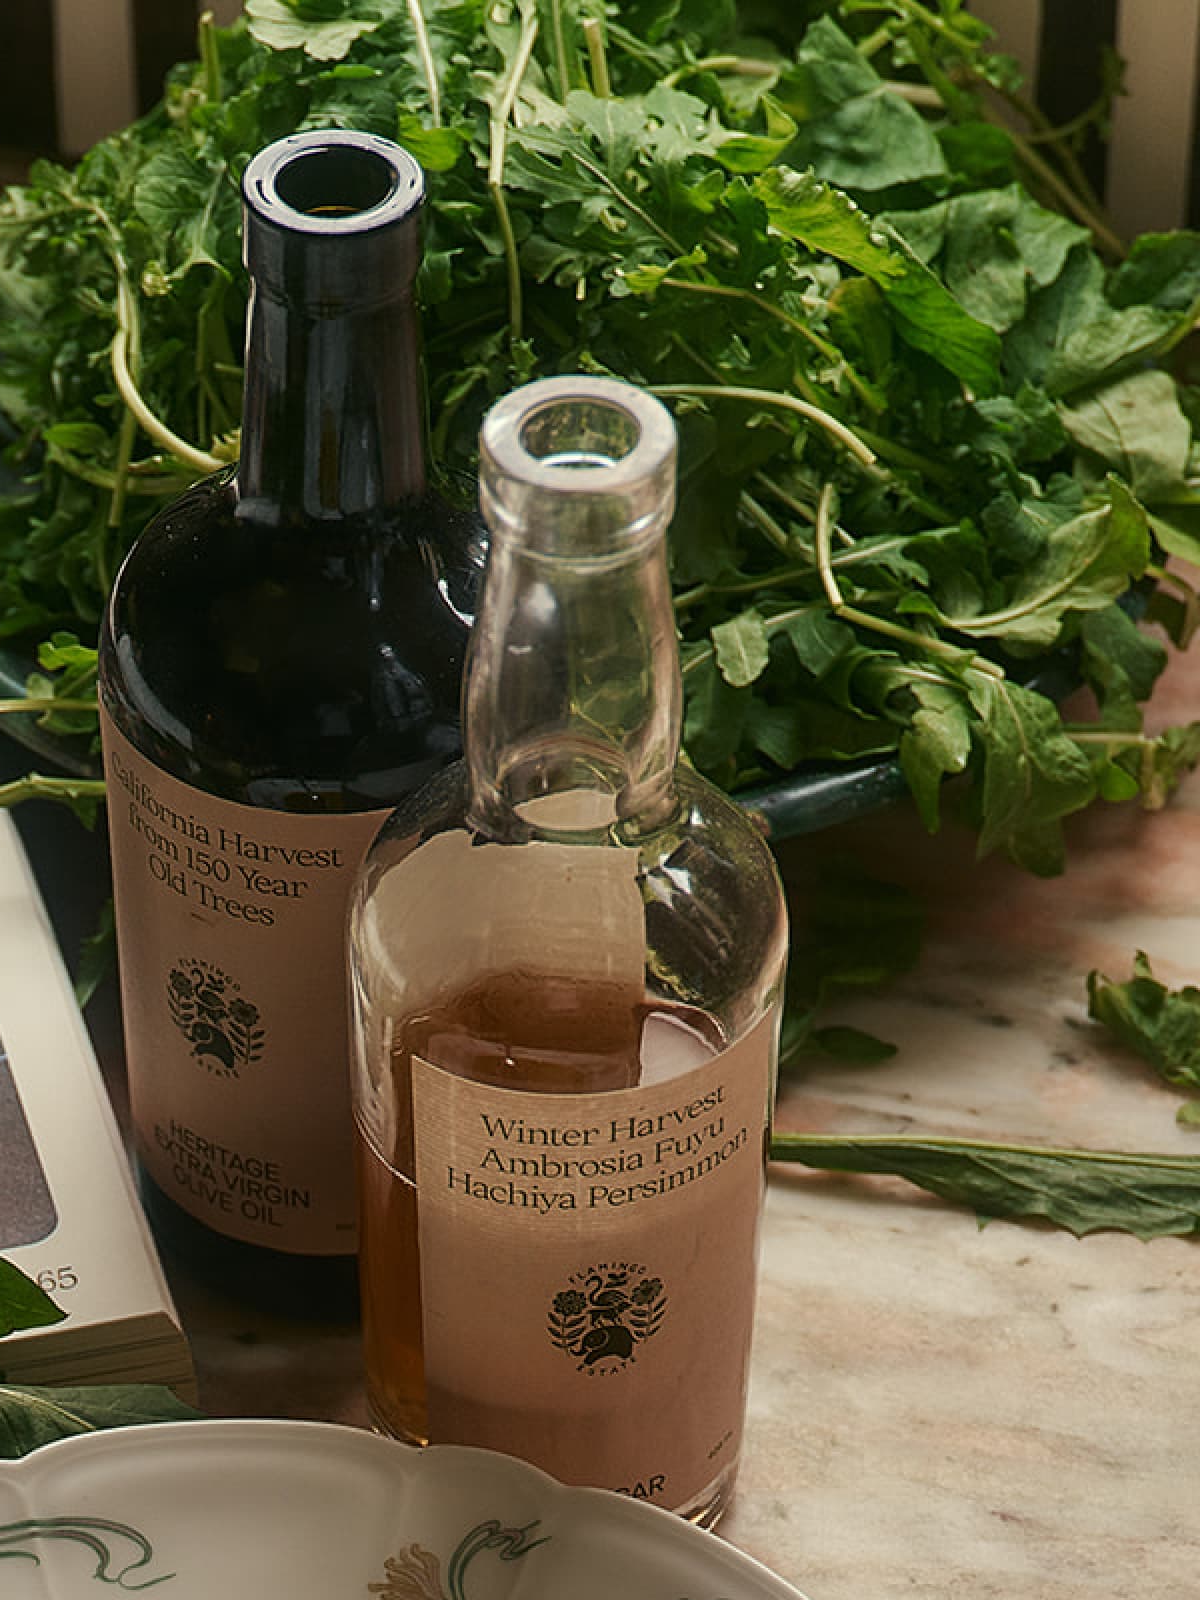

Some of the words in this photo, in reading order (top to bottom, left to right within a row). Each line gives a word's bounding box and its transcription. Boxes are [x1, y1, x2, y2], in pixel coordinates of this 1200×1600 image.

[112, 752, 209, 845] California
[218, 829, 344, 868] Harvest
[149, 853, 188, 896] Old
[191, 879, 276, 926] Trees
[187, 846, 231, 882] 150
[238, 866, 308, 898] Year
[480, 1113, 599, 1147] Winter
[609, 1085, 725, 1143] Harvest
[170, 1119, 281, 1184] HERITAGE
[447, 1165, 577, 1215] Hachiya
[589, 1127, 748, 1209] Persimmon
[480, 1147, 643, 1179] Ambrosia
[655, 1116, 725, 1164] Fuyu
[222, 1170, 311, 1209] VIRGIN
[241, 1199, 284, 1228] OIL
[36, 1265, 79, 1292] 65
[614, 1474, 666, 1499] AR
